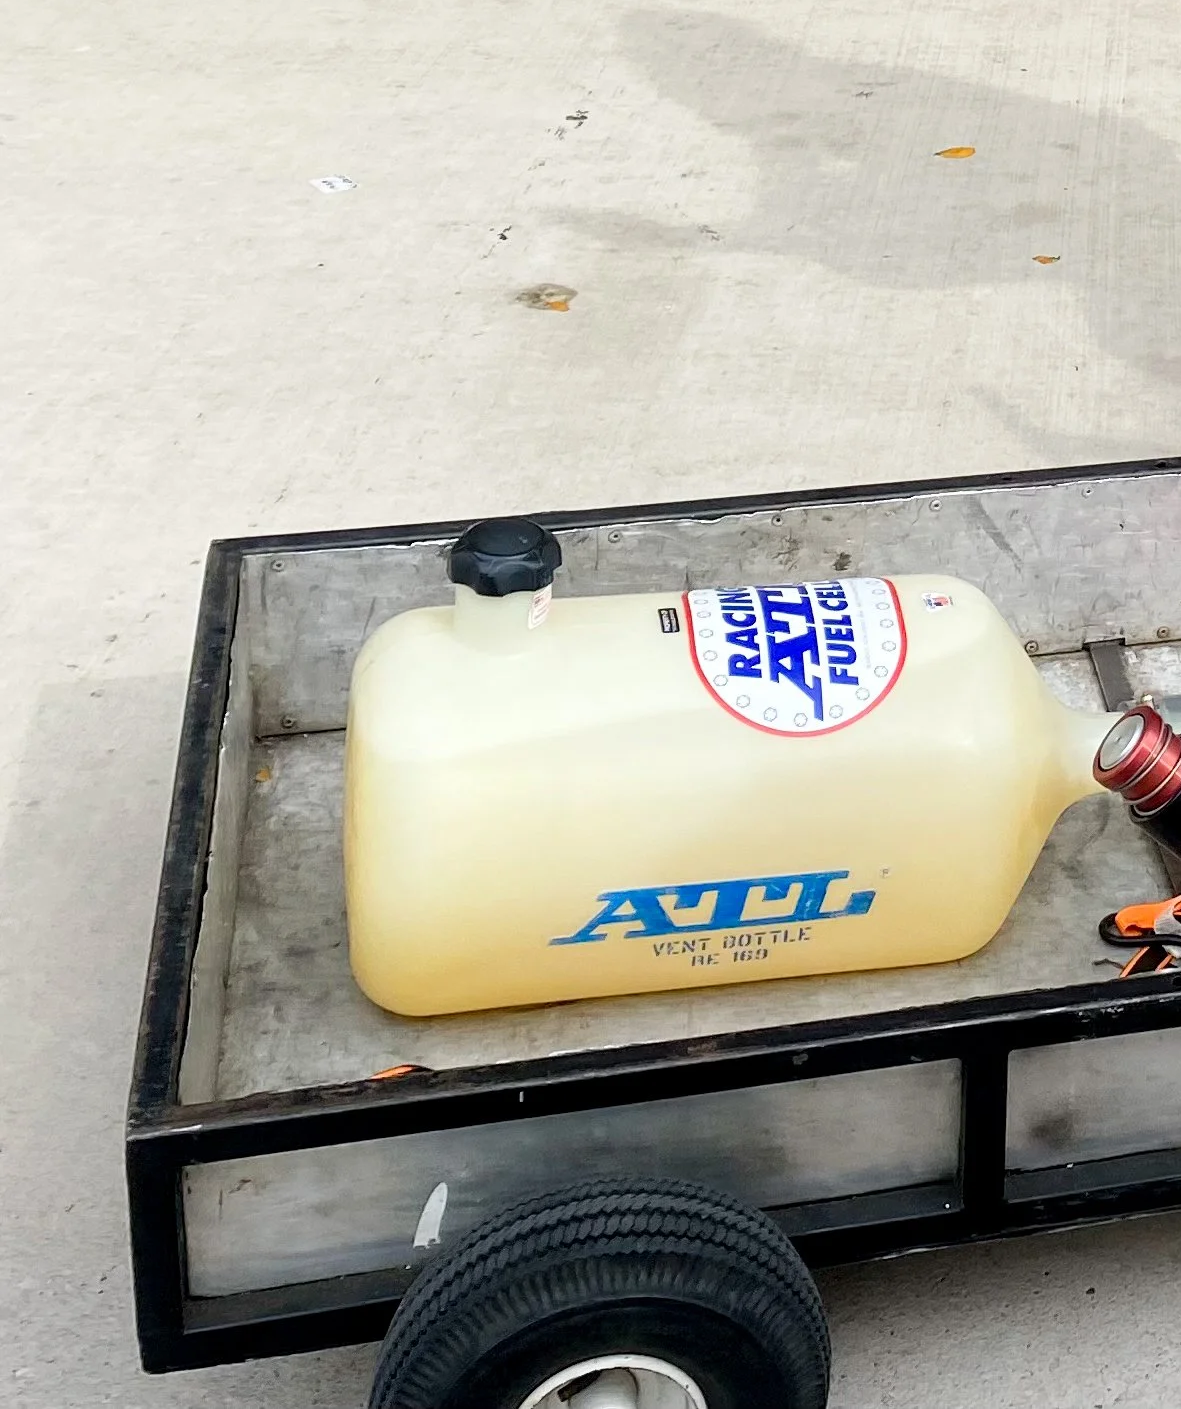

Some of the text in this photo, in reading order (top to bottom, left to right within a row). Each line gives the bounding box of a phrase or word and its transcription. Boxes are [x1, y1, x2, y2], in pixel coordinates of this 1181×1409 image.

[754, 582, 824, 722] AT
[821, 614, 860, 686] FUEL
[547, 869, 877, 947] ATL
[652, 926, 813, 957] VENT BOTTLE
[733, 947, 769, 963] 169
